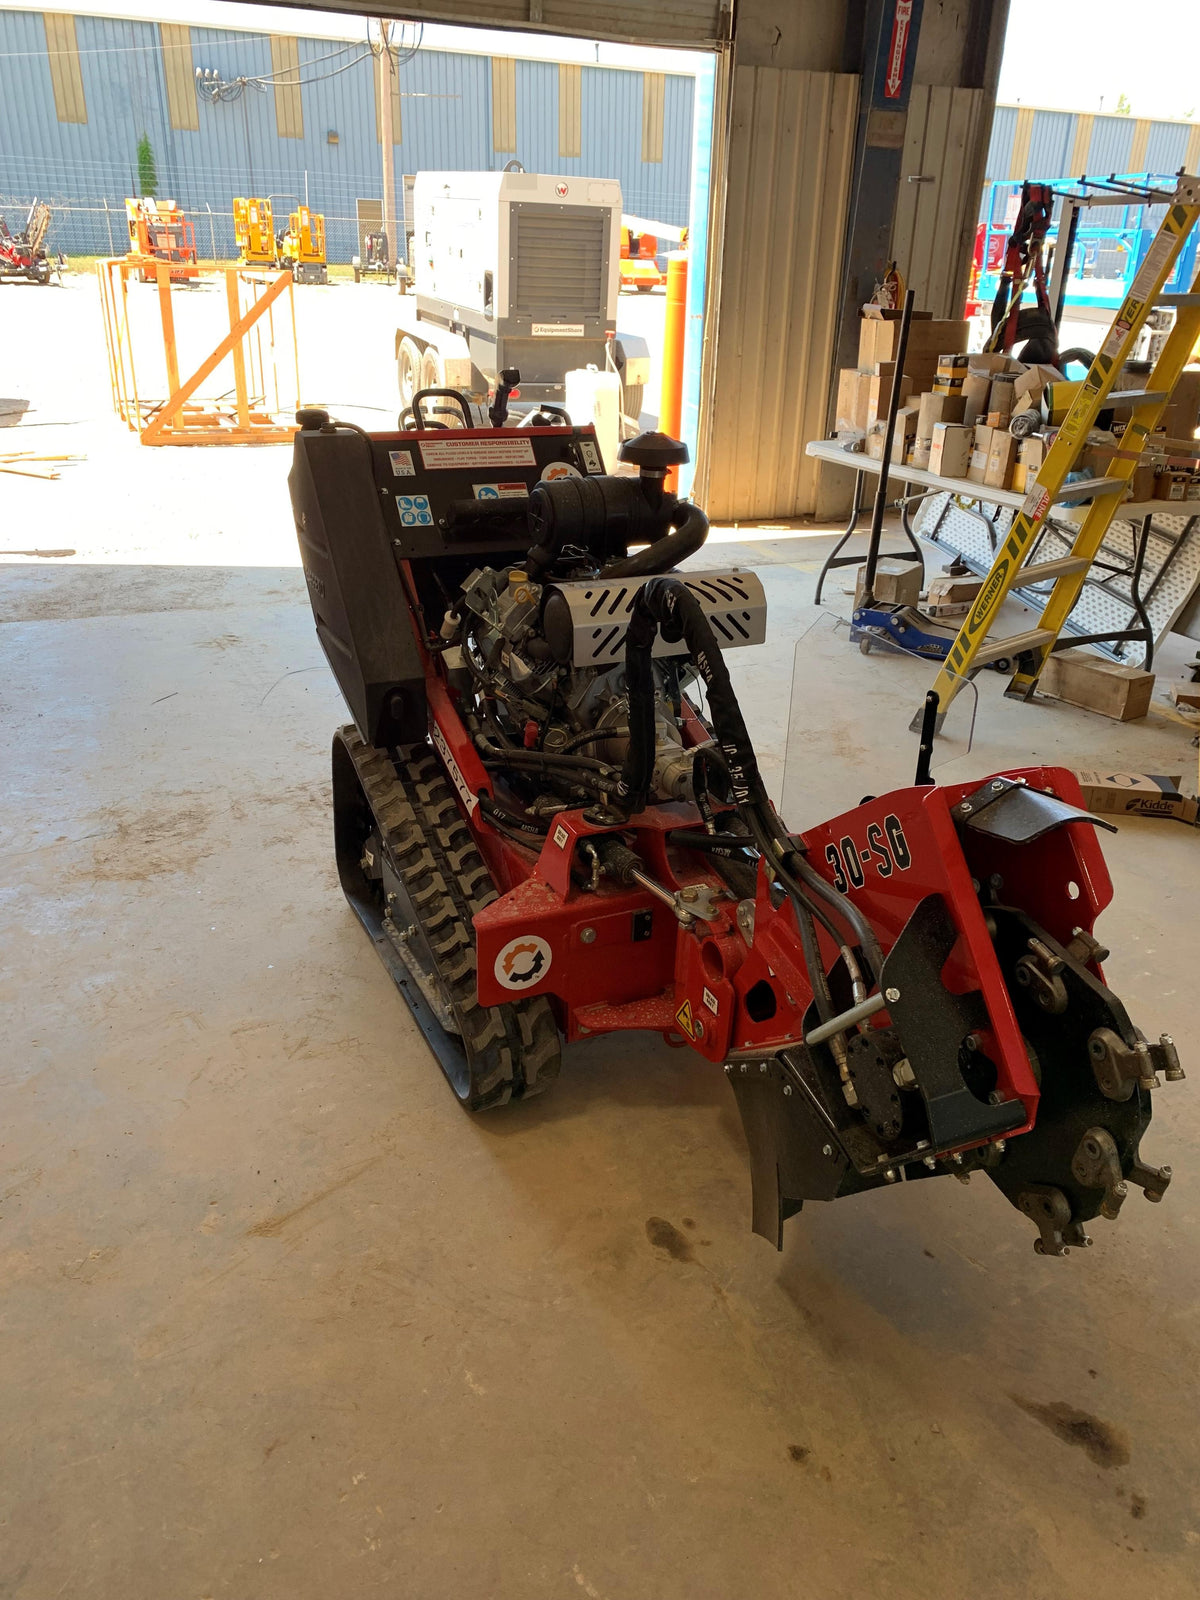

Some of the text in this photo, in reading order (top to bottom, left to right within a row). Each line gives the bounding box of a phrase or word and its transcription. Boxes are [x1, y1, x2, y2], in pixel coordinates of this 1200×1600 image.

[897, 6, 910, 16] FIRE
[891, 20, 904, 89] EXTINGUISHER
[976, 572, 1004, 620] WERNER
[1140, 799, 1174, 811] Kidde
[825, 813, 912, 895] 30-SG
